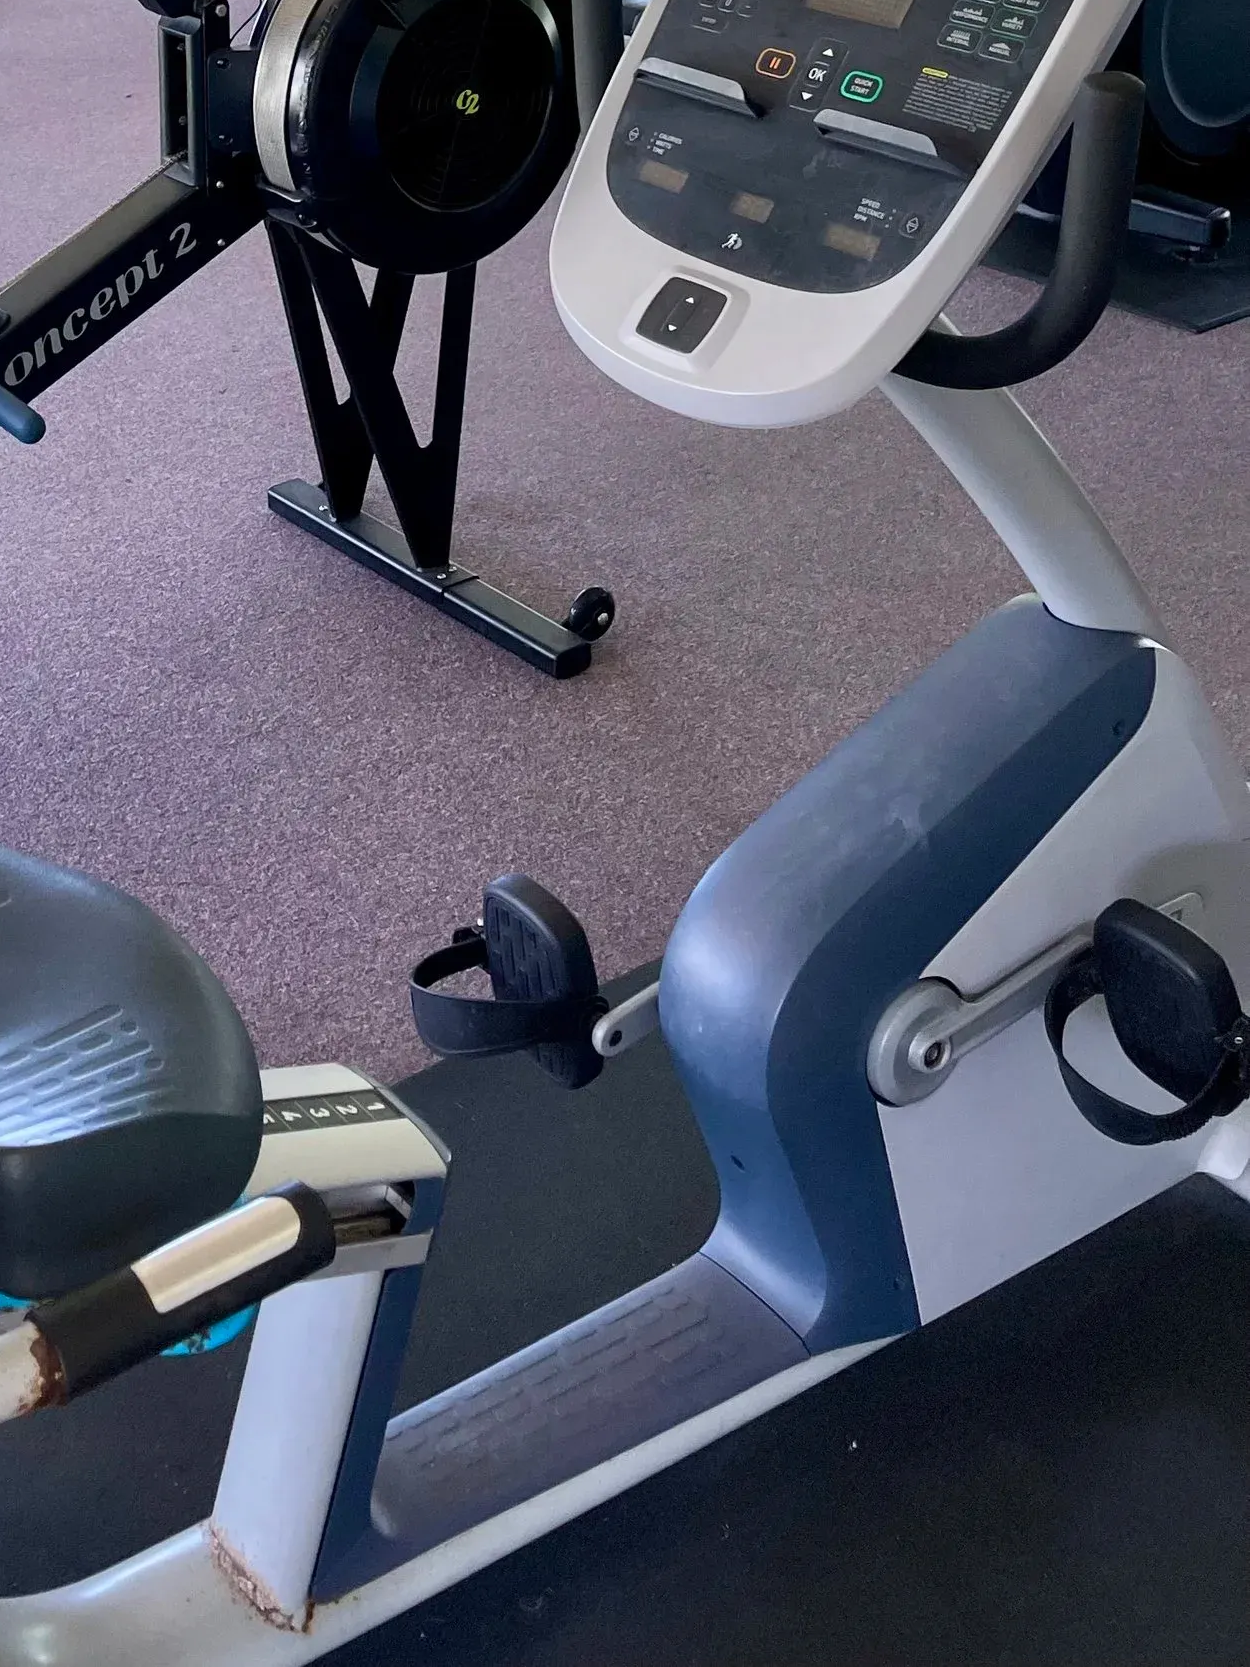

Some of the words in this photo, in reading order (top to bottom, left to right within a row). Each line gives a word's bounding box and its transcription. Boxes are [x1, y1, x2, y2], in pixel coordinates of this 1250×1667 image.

[808, 67, 827, 82] OK
[854, 77, 874, 87] QUICK
[850, 86, 870, 95] START
[861, 198, 881, 209] SPEED
[853, 213, 868, 222] RPM
[857, 206, 885, 219] DISTANCE
[169, 222, 197, 259] 2
[335, 1104, 358, 1115] 2
[367, 1102, 386, 1111] 1
[281, 1110, 302, 1122] 4
[310, 1107, 330, 1118] 3
